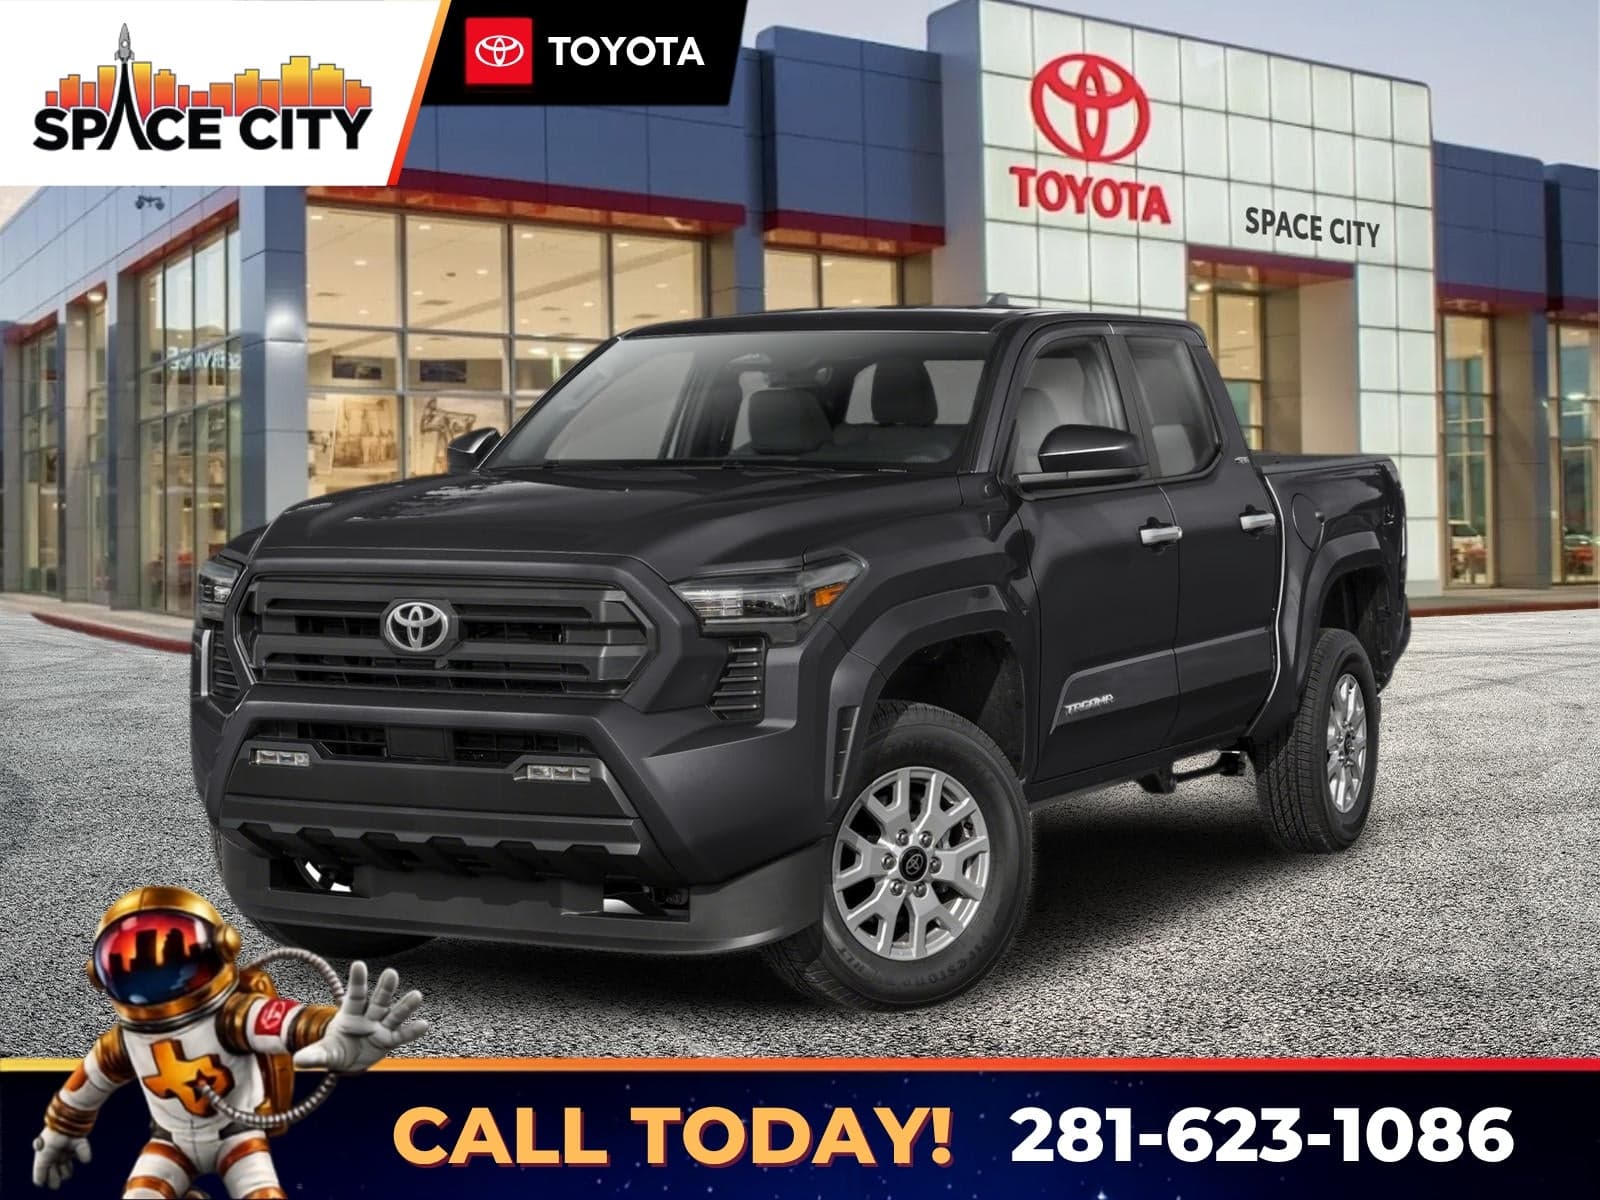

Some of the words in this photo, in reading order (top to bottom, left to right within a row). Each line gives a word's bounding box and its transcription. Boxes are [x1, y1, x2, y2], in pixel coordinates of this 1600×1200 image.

[1008, 165, 1172, 225] TOYOTA
[1245, 206, 1322, 242] SPACE
[1329, 217, 1380, 248] CITY
